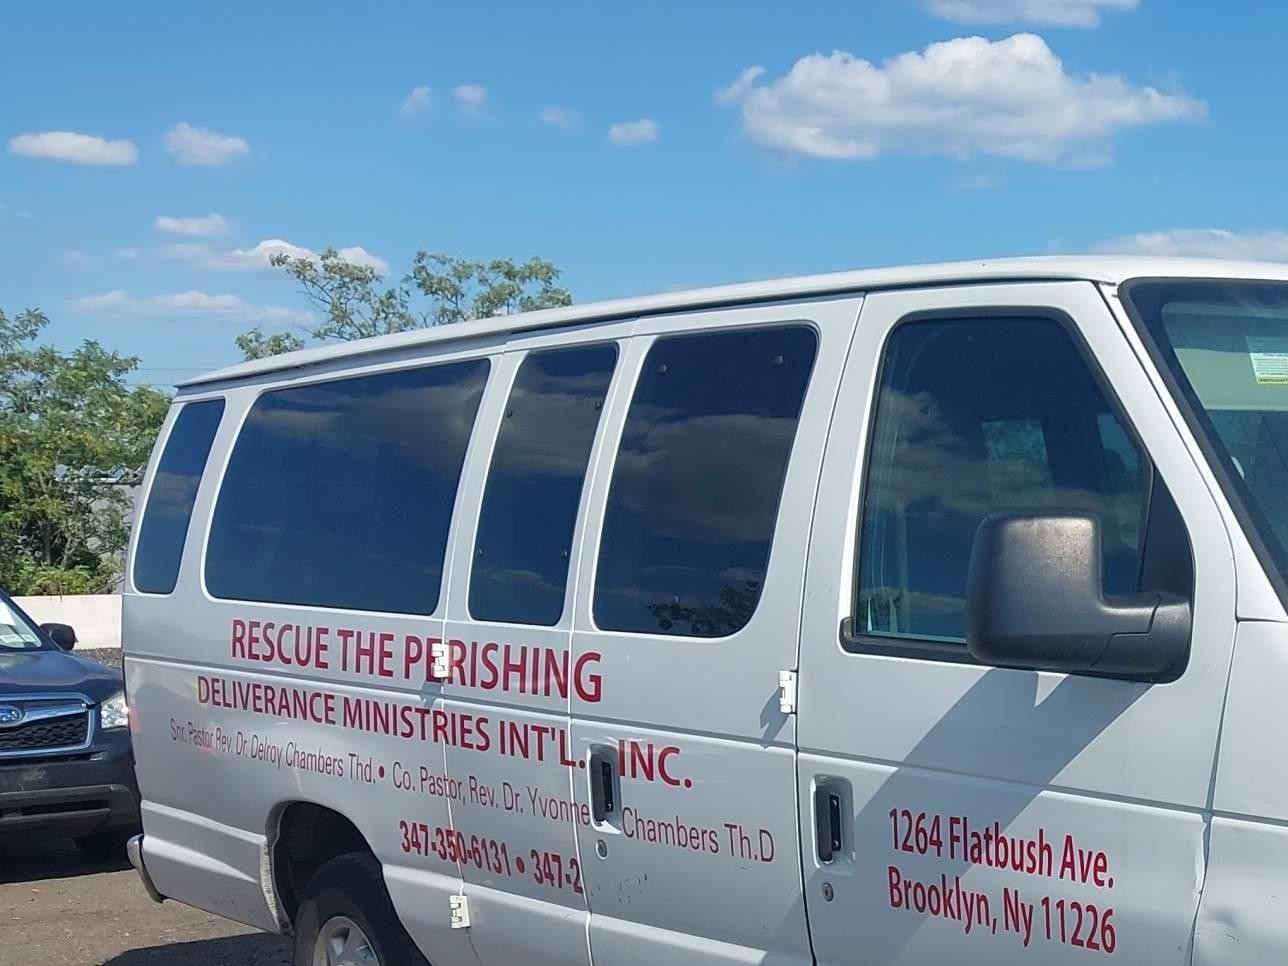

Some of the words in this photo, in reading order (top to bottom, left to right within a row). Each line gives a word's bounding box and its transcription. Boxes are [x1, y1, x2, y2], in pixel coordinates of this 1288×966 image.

[231, 619, 329, 669] RESCUE
[337, 629, 394, 677] THE
[404, 635, 602, 702] PERISHING
[197, 675, 336, 726] DELIVERANCE
[342, 697, 490, 752] MINISTRIES
[499, 720, 586, 769] INT'L.
[618, 739, 693, 788] INC.
[187, 721, 214, 748] Pastor
[216, 727, 233, 754] Rev.
[236, 731, 248, 758] Dr.
[251, 734, 282, 771] Delroy
[285, 741, 344, 777] Chambers
[392, 761, 416, 792] Co.
[469, 775, 499, 809] Rev.
[502, 781, 524, 814] Dr.
[526, 786, 590, 826] Yvonne
[622, 806, 719, 854] Chambers
[724, 823, 775, 863] Th.D
[400, 820, 512, 877] 347-350-6131
[889, 808, 943, 857] 1264
[950, 817, 1052, 877] Flatbush
[1059, 833, 1114, 889] Ave.
[888, 865, 998, 935] Brooklyn,
[1003, 887, 1034, 948] Ny
[1041, 896, 1117, 954] 11226
